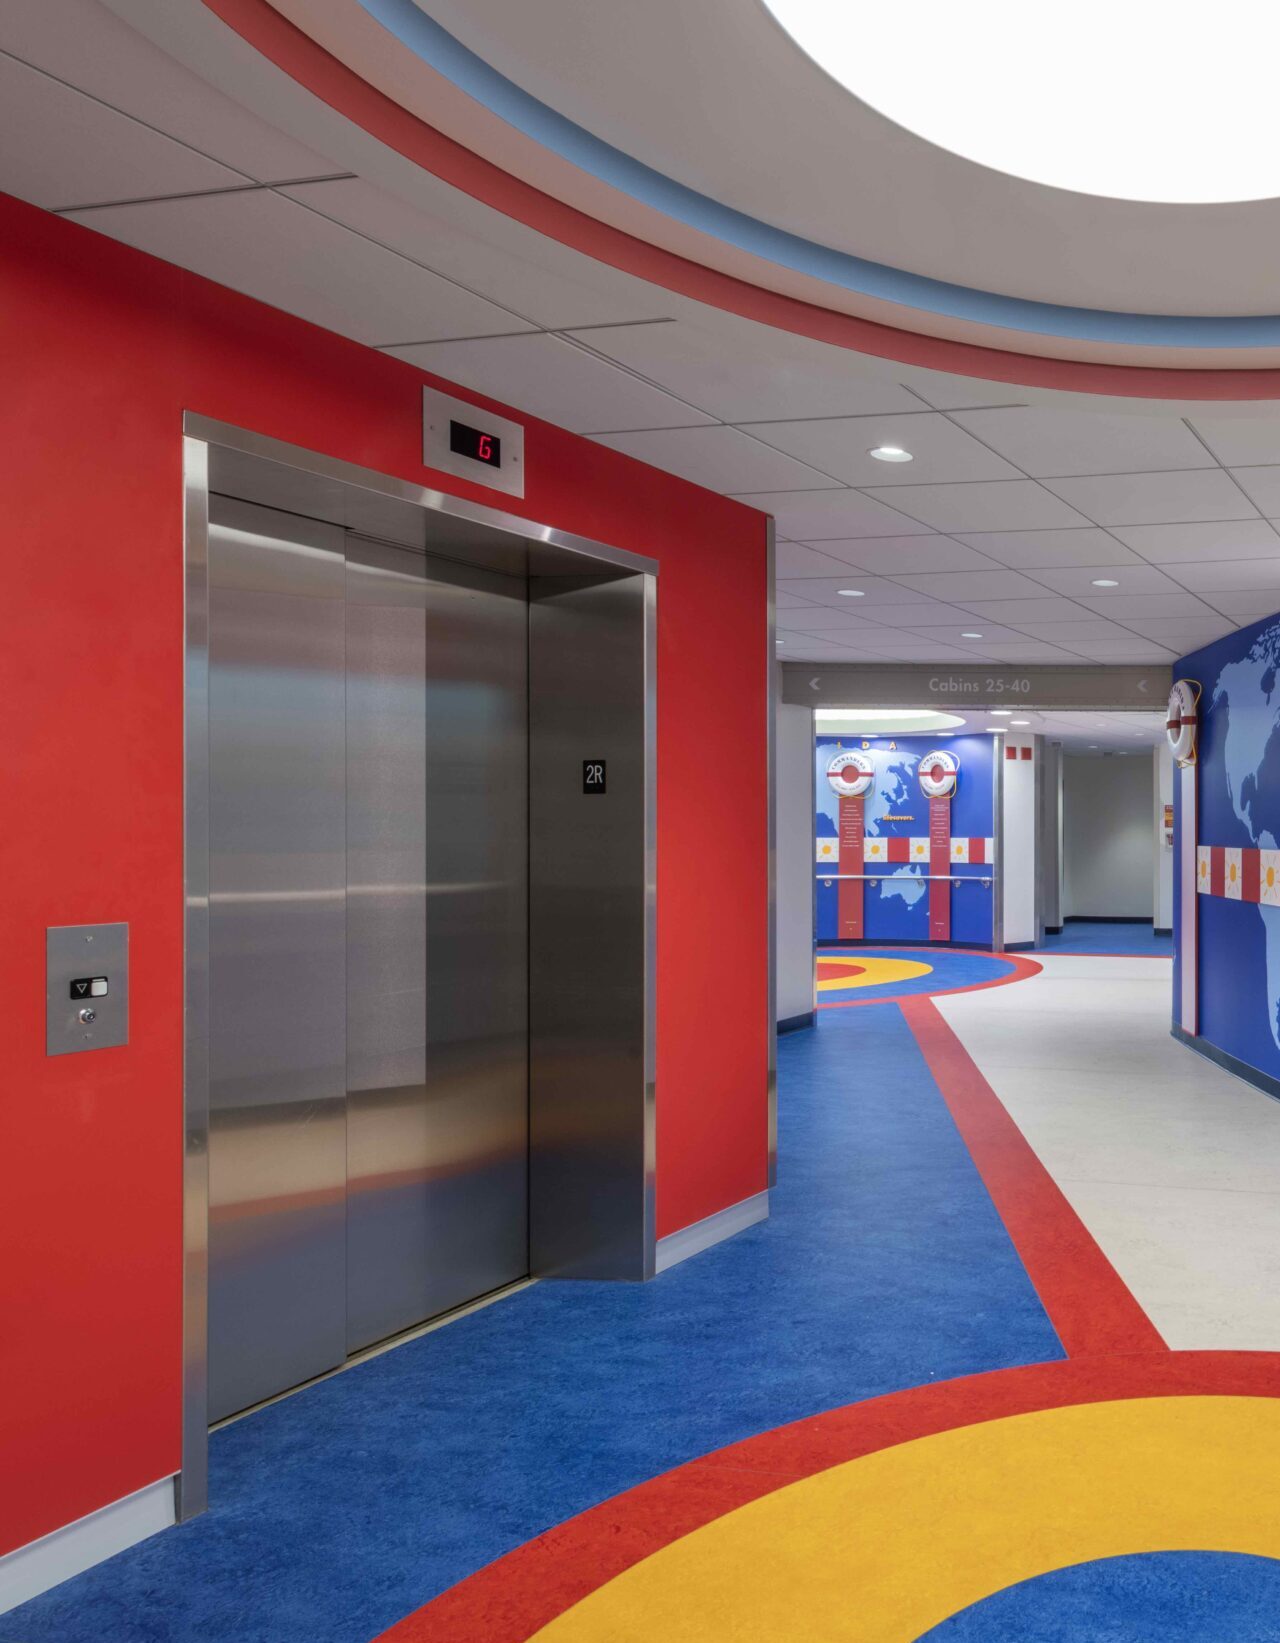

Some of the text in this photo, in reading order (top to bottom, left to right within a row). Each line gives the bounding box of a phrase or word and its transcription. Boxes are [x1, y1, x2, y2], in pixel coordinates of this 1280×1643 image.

[929, 677, 1031, 692] Cabins 25-40
[586, 765, 603, 783] 2R
